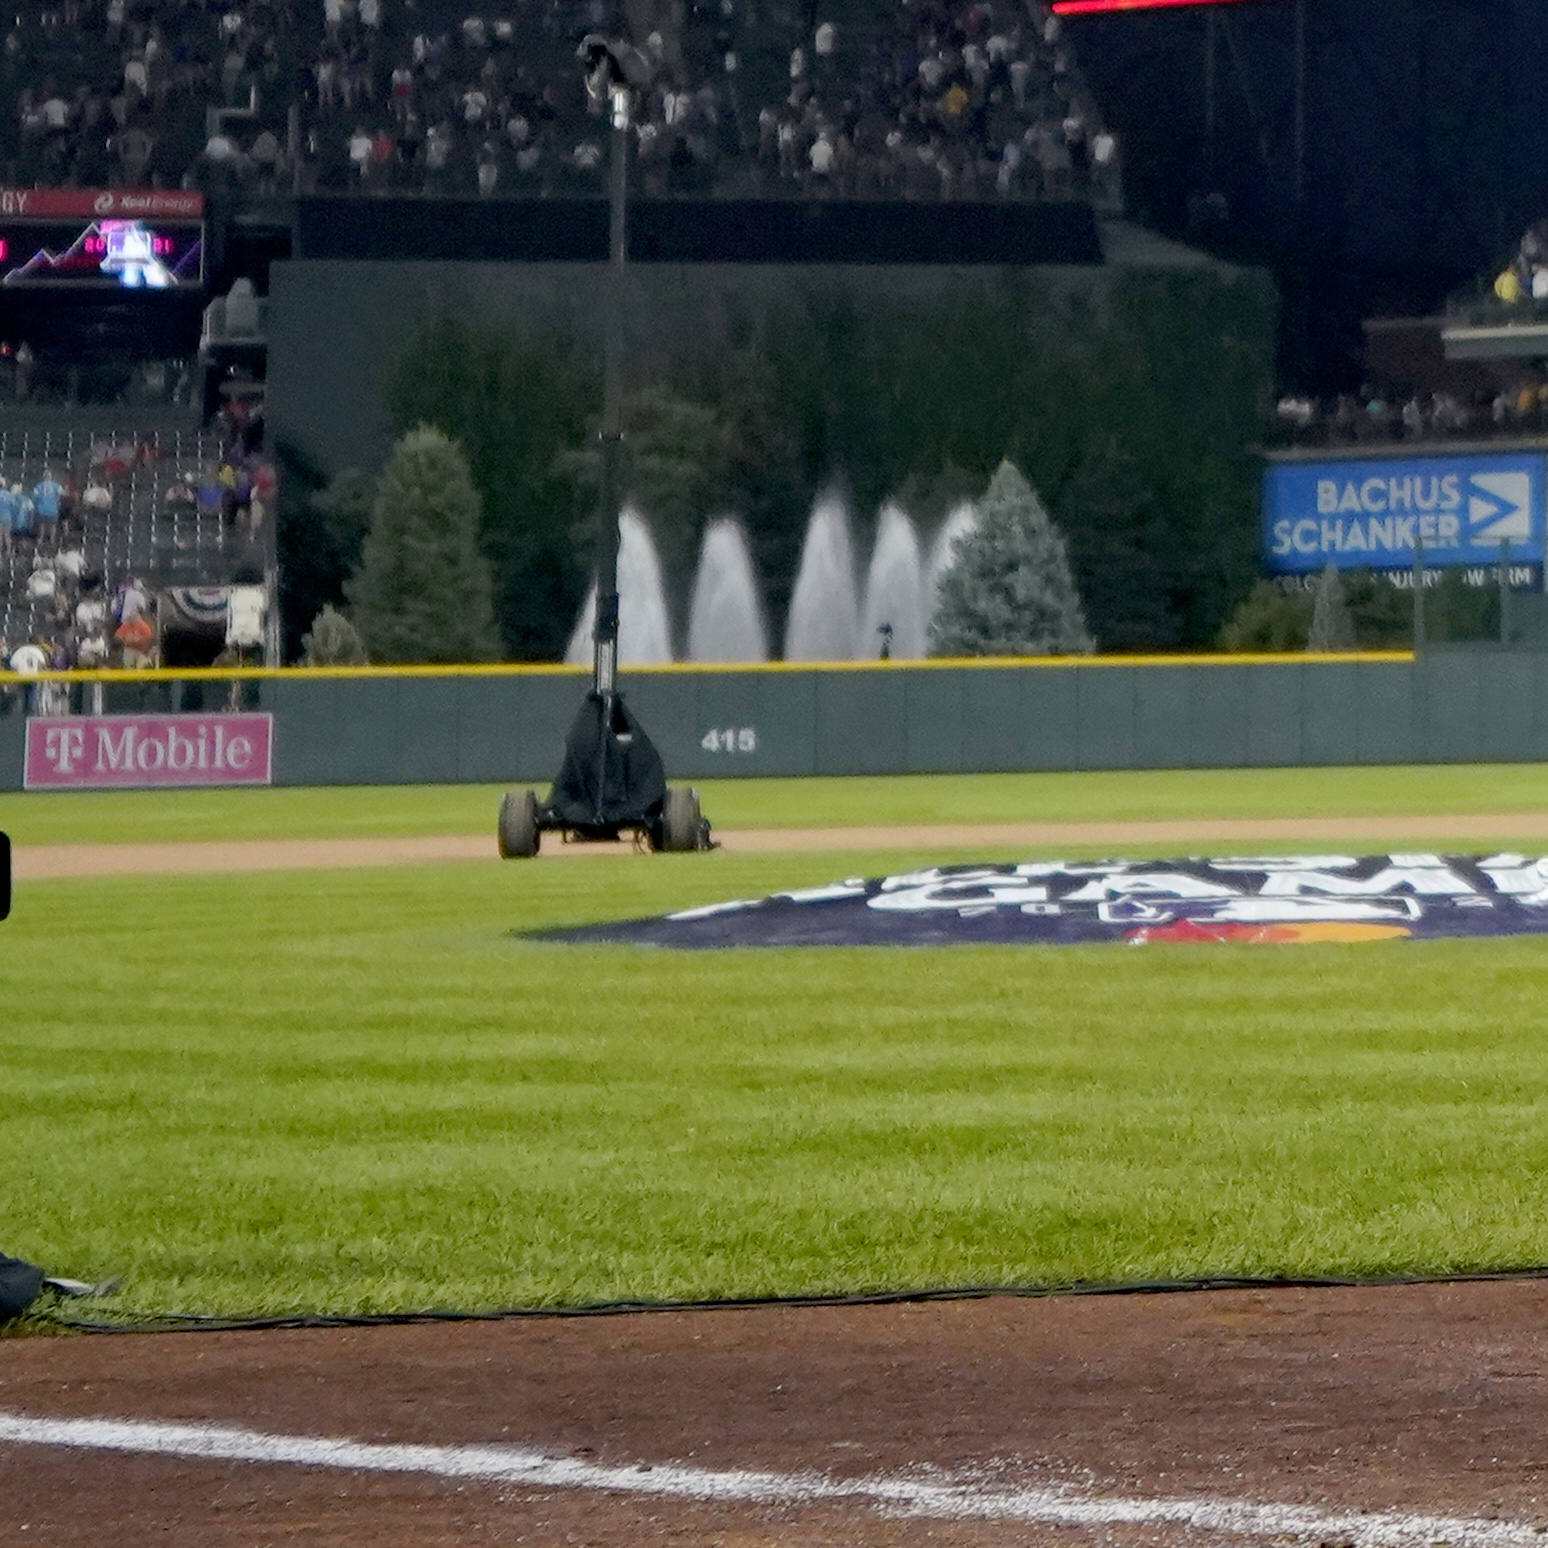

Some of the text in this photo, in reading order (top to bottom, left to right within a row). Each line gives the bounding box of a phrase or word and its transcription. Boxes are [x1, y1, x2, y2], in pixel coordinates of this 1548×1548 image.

[1317, 475, 1461, 515] BACHUS
[1271, 514, 1461, 556] SCHANKER
[94, 723, 252, 770] Mobile
[701, 727, 756, 752] 415
